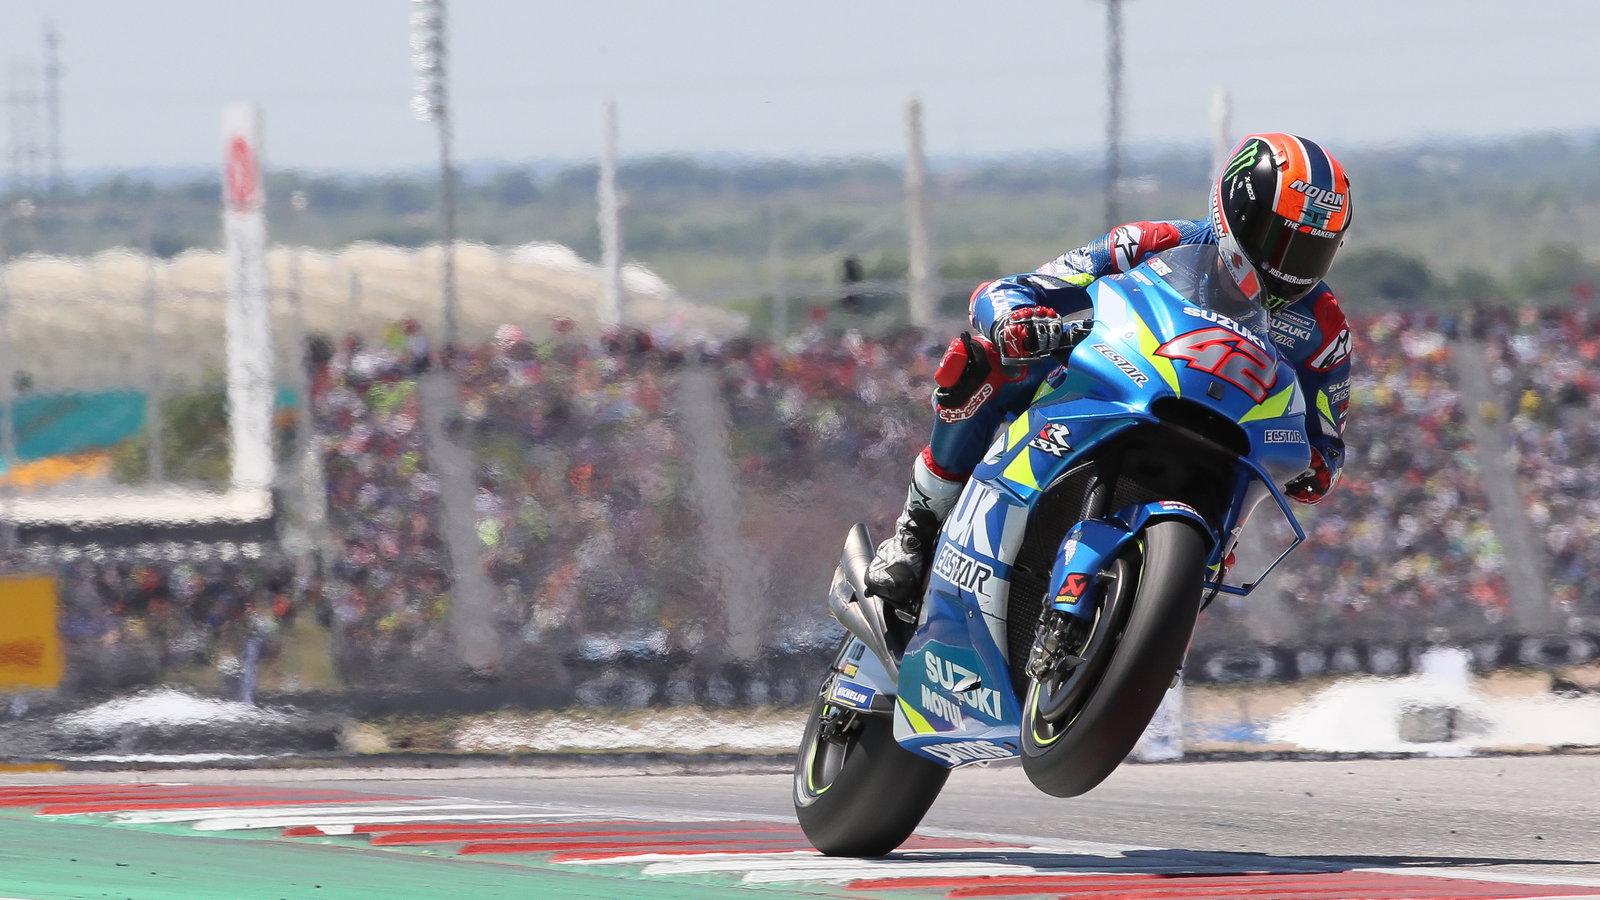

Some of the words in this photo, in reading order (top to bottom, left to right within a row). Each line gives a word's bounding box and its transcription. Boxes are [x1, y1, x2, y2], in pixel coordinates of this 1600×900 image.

[1289, 179, 1345, 211] NOLAN
[1284, 219, 1300, 231] THE
[1310, 228, 1337, 239] BAKERY
[1183, 306, 1267, 351] SUZUKI
[1269, 316, 1312, 341] UZUKI
[1282, 312, 1312, 327] MICHELIN
[1092, 344, 1149, 389] ECSTAR
[1152, 326, 1278, 405] 42
[1265, 429, 1306, 444] ECSTAR
[934, 545, 992, 598] ECSTAR
[920, 683, 966, 731] MOTUL
[925, 650, 1002, 721] SUZUKI
